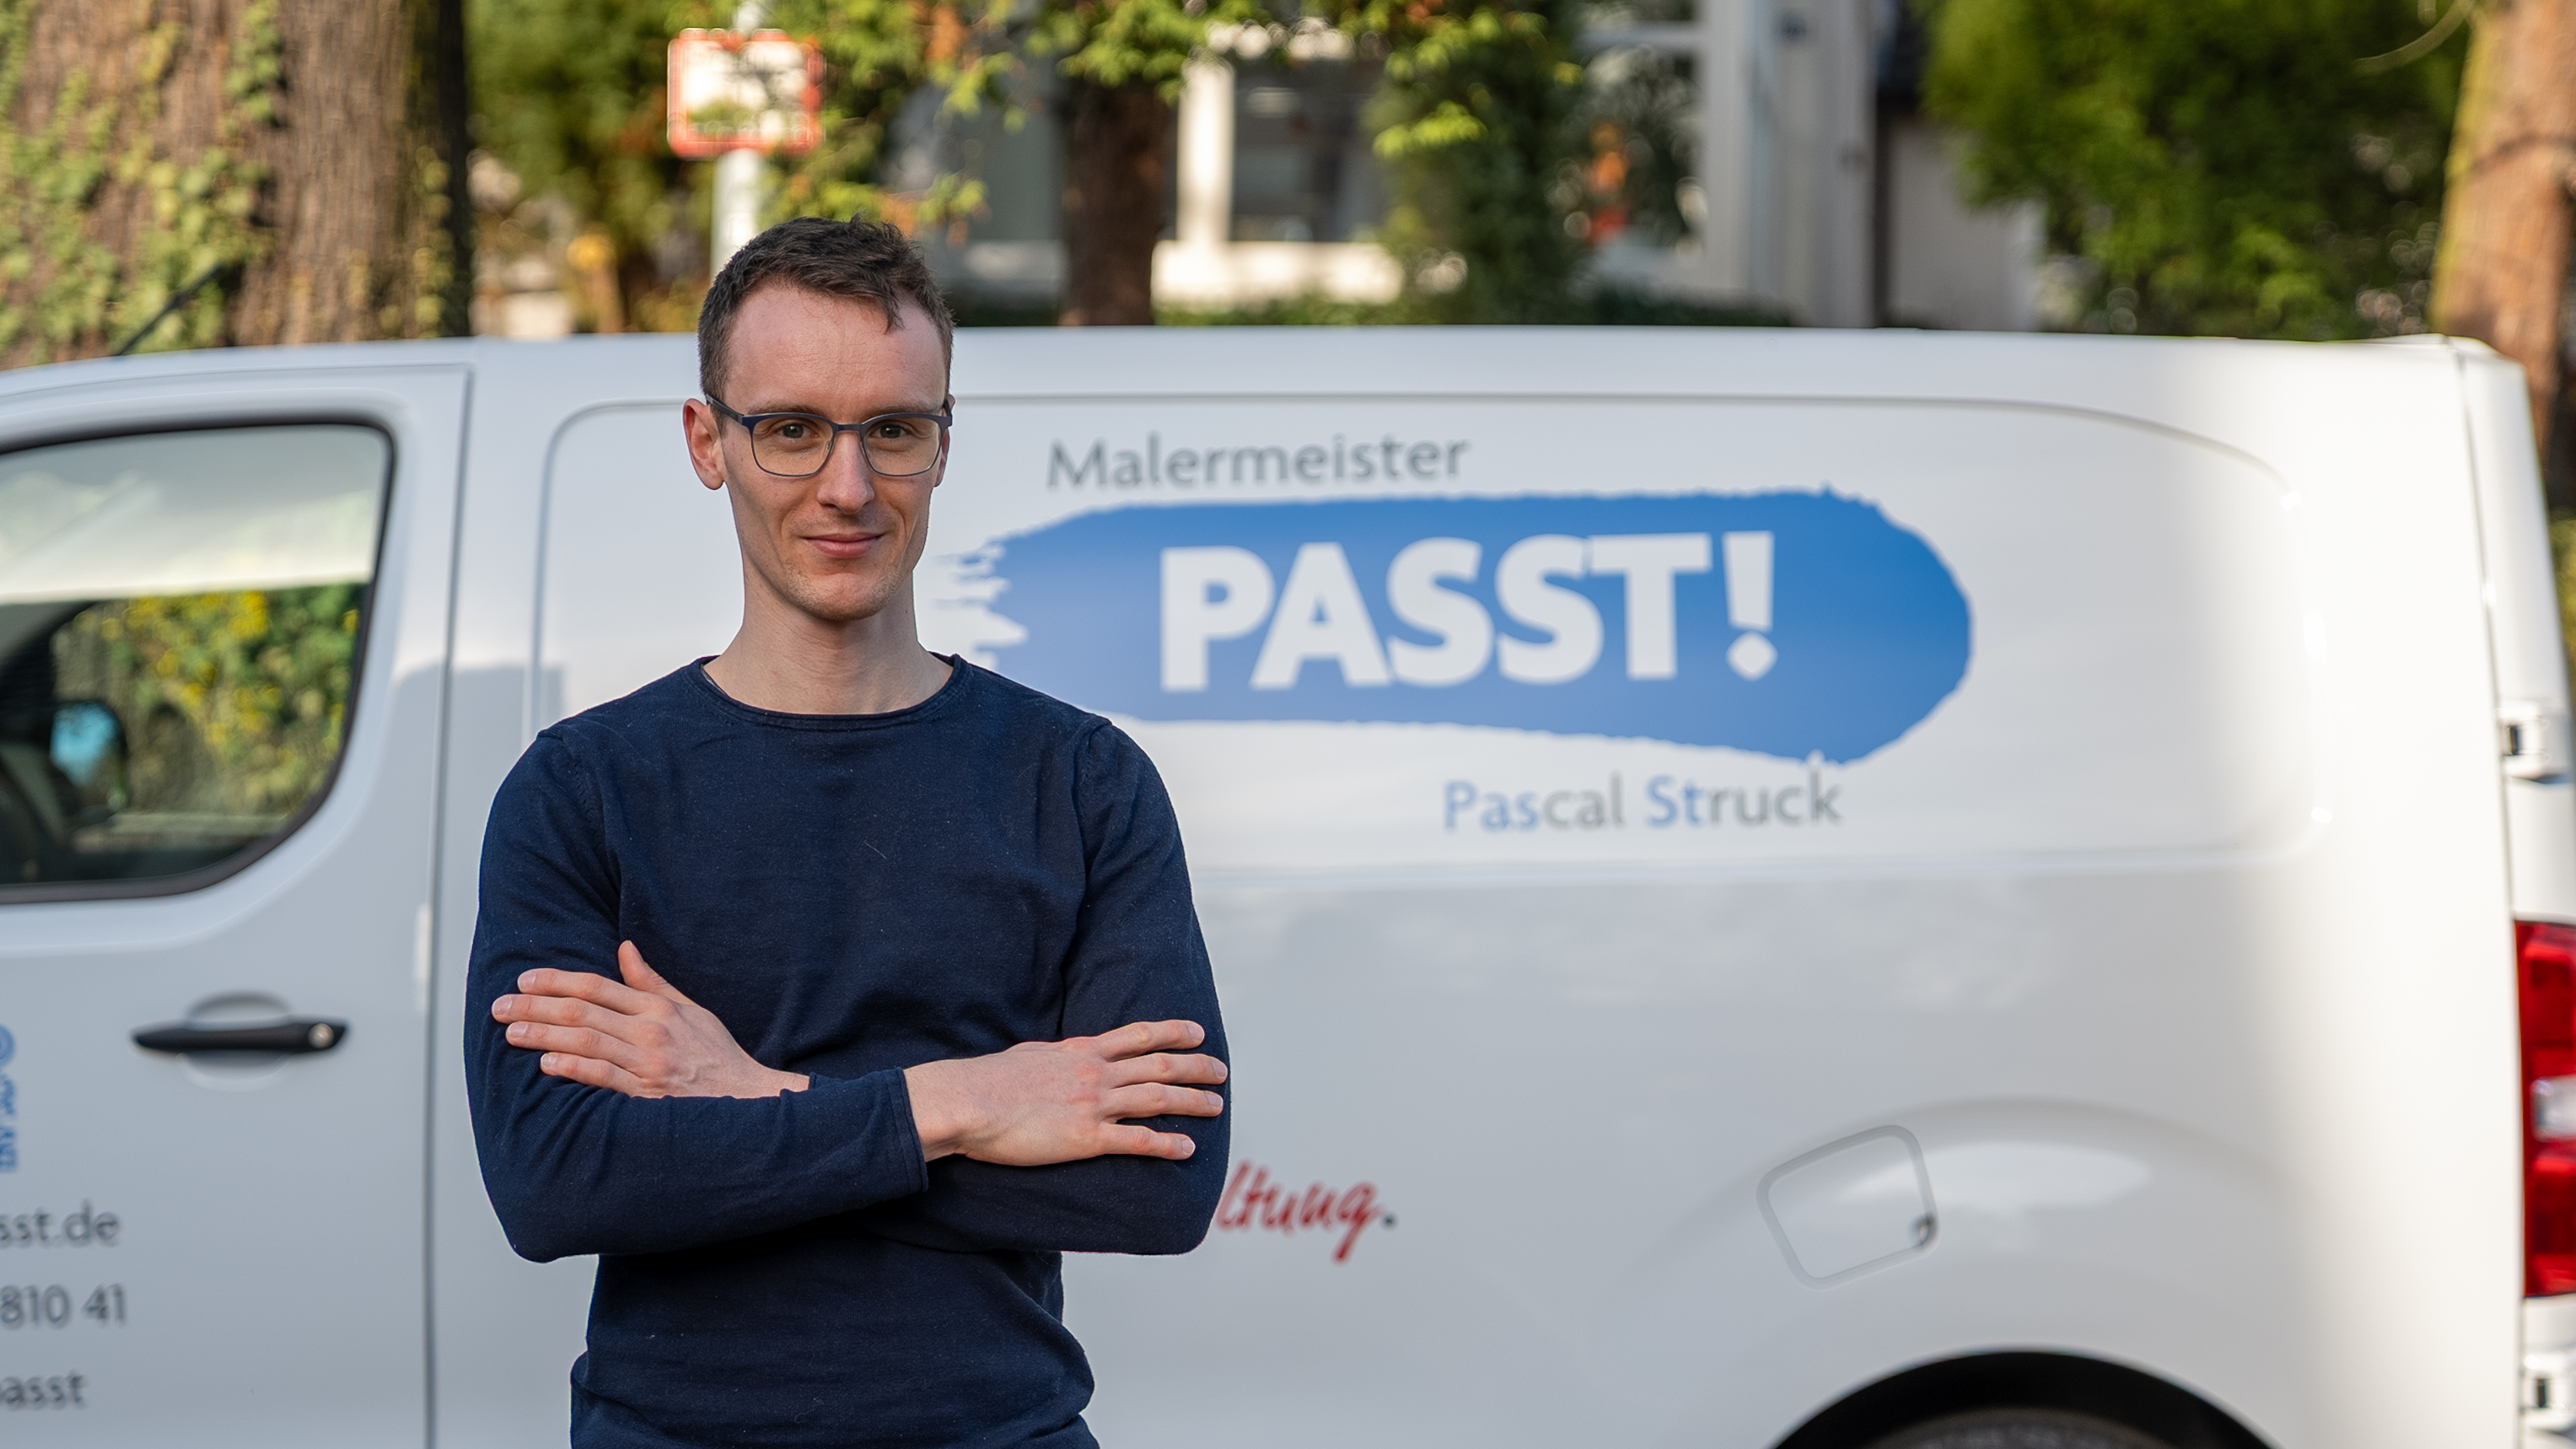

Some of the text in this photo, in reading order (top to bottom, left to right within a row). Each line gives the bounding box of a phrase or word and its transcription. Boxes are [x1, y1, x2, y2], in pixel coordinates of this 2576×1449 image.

[1046, 431, 1469, 490] Malermeister
[1161, 531, 1777, 692] PASST!
[1444, 762, 1845, 834] Pascal Struck
[0, 1284, 127, 1329] 810 41
